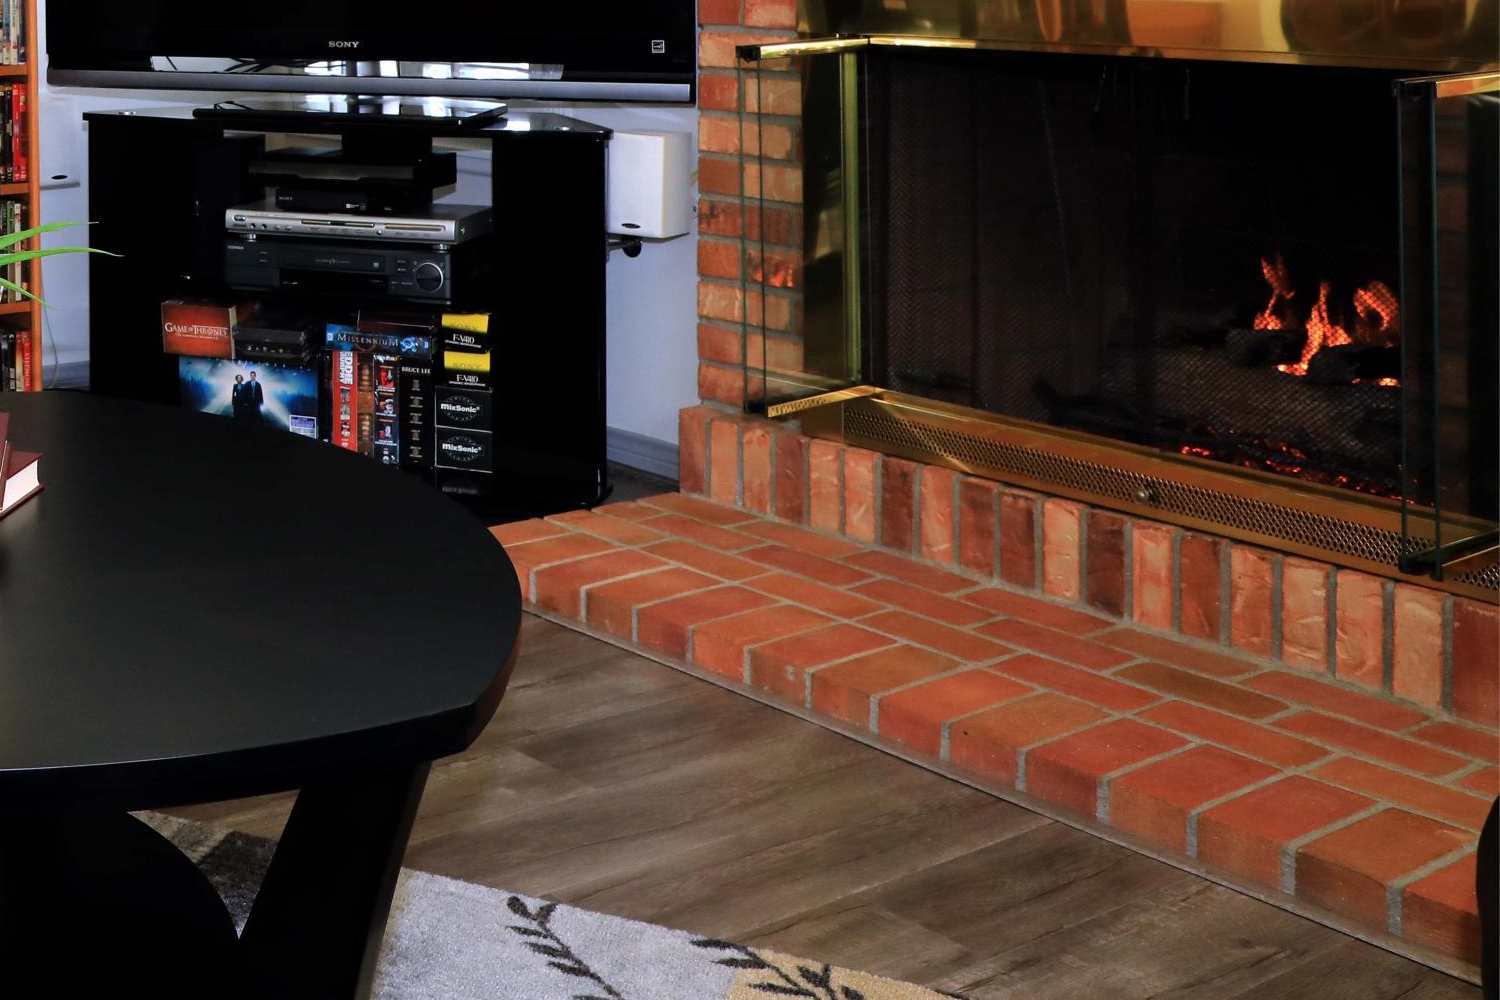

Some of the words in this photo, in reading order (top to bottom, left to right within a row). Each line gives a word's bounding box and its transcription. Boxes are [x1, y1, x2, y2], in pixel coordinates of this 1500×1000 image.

[164, 322, 188, 333] GAME
[192, 324, 228, 337] THRONES
[337, 333, 399, 347] MILLENNIUM
[401, 366, 420, 374] BRUCE
